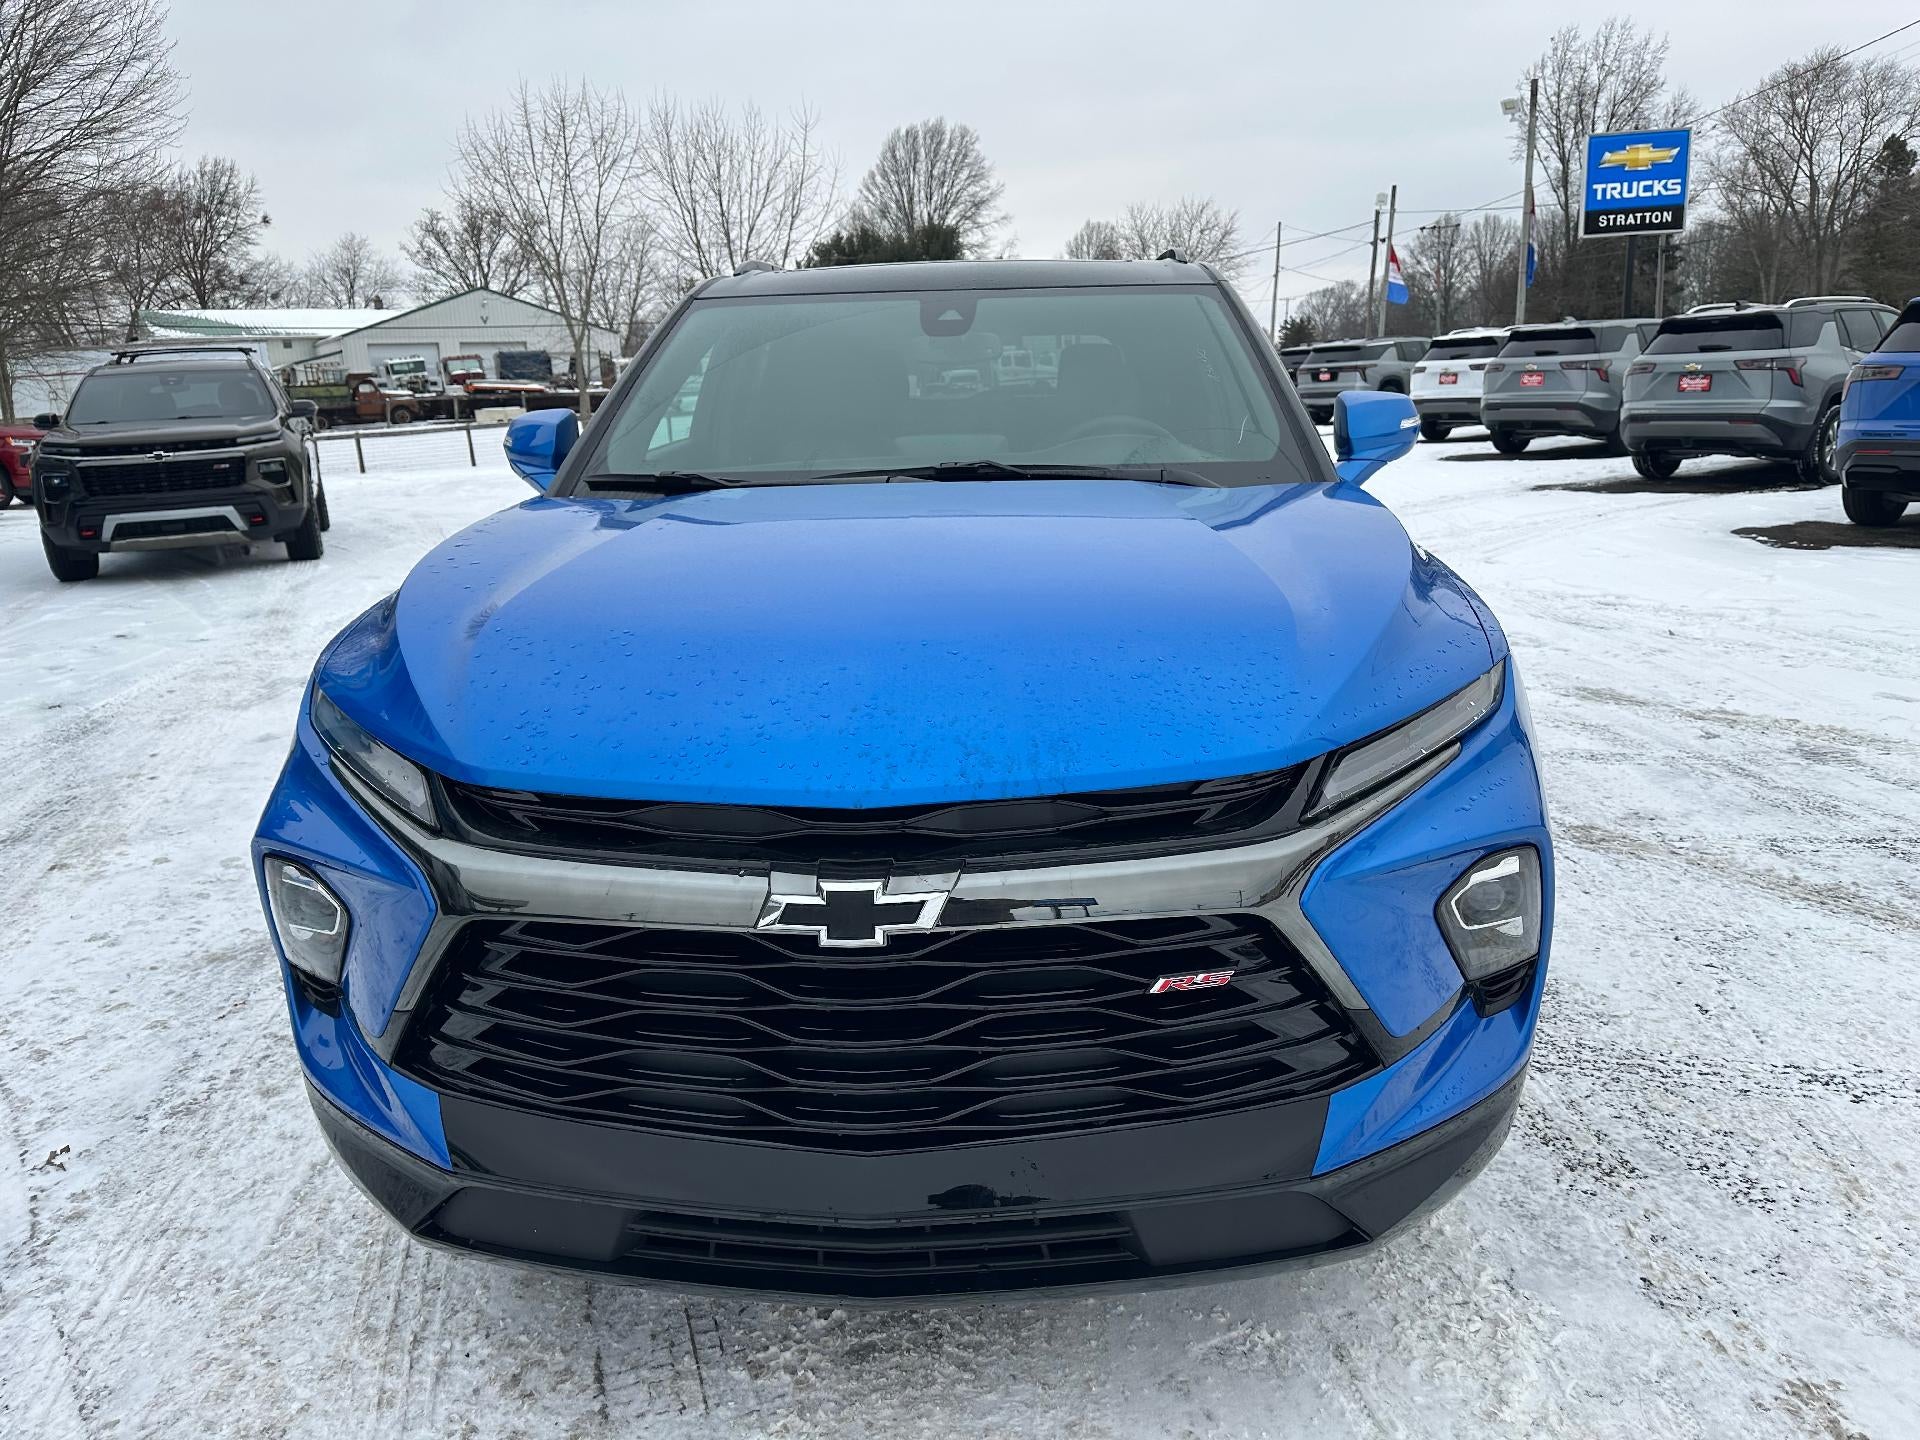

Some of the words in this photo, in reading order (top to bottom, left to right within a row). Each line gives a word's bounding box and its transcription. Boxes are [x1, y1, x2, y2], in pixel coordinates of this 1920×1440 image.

[1592, 179, 1682, 200] TRUCKS
[1598, 211, 1672, 227] STRATTON
[1150, 970, 1235, 993] RS
